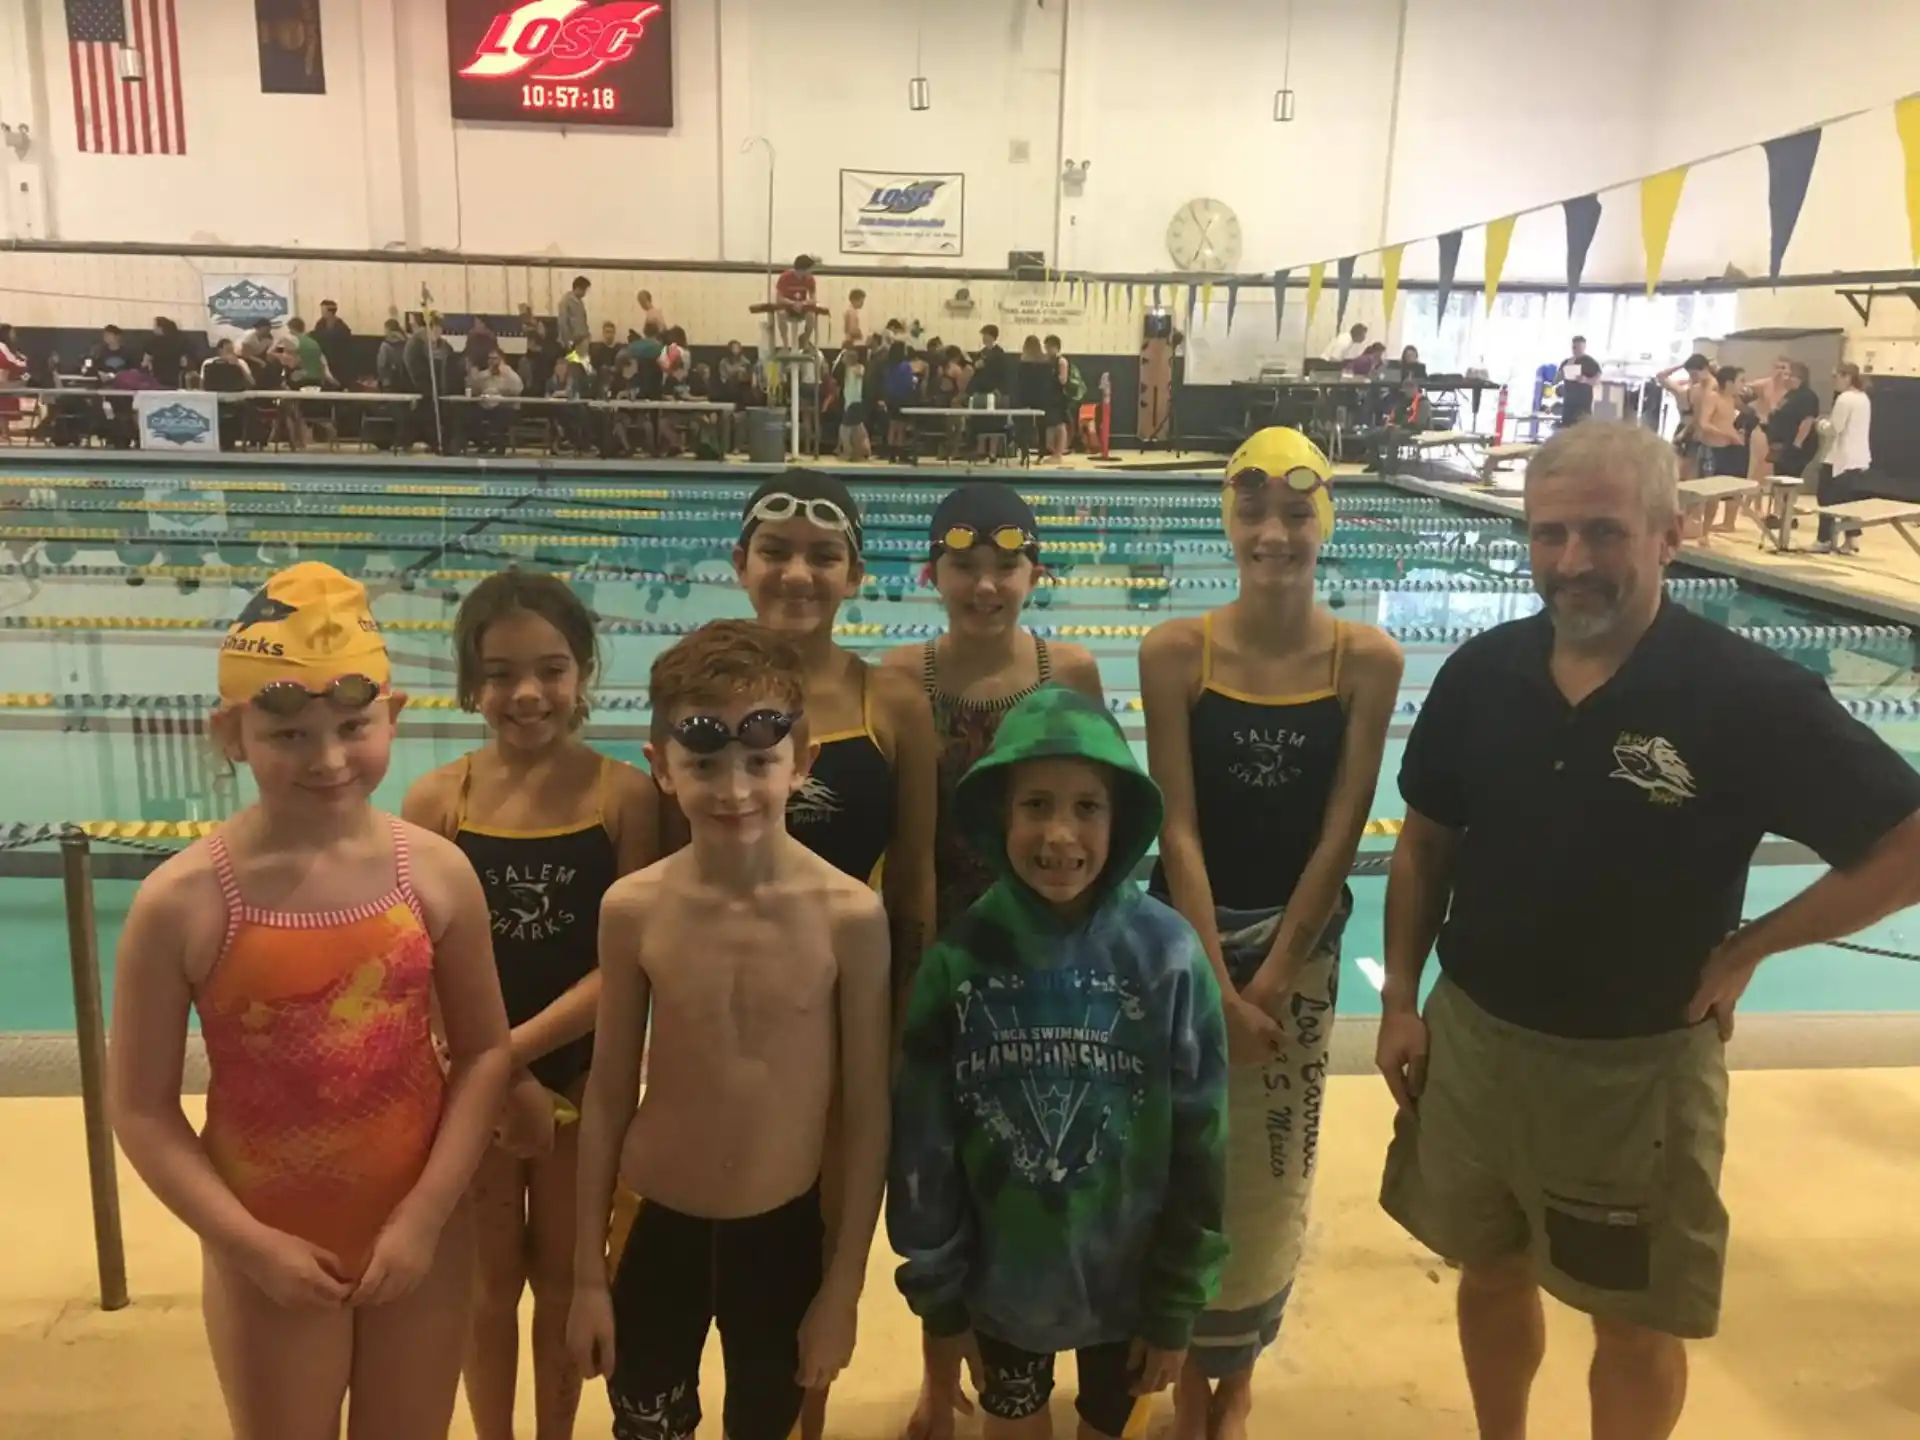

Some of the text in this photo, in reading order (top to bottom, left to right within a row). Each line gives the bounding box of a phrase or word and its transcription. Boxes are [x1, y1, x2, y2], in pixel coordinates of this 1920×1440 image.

[475, 14, 644, 61] LOSC
[522, 85, 615, 109] 10:57:18
[214, 298, 284, 311] CASCADIA
[1233, 728, 1306, 749] SALEM
[485, 863, 577, 886] SALEM
[1290, 991, 1330, 1049] Los
[991, 1026, 1110, 1044] YMCA SWIMMING
